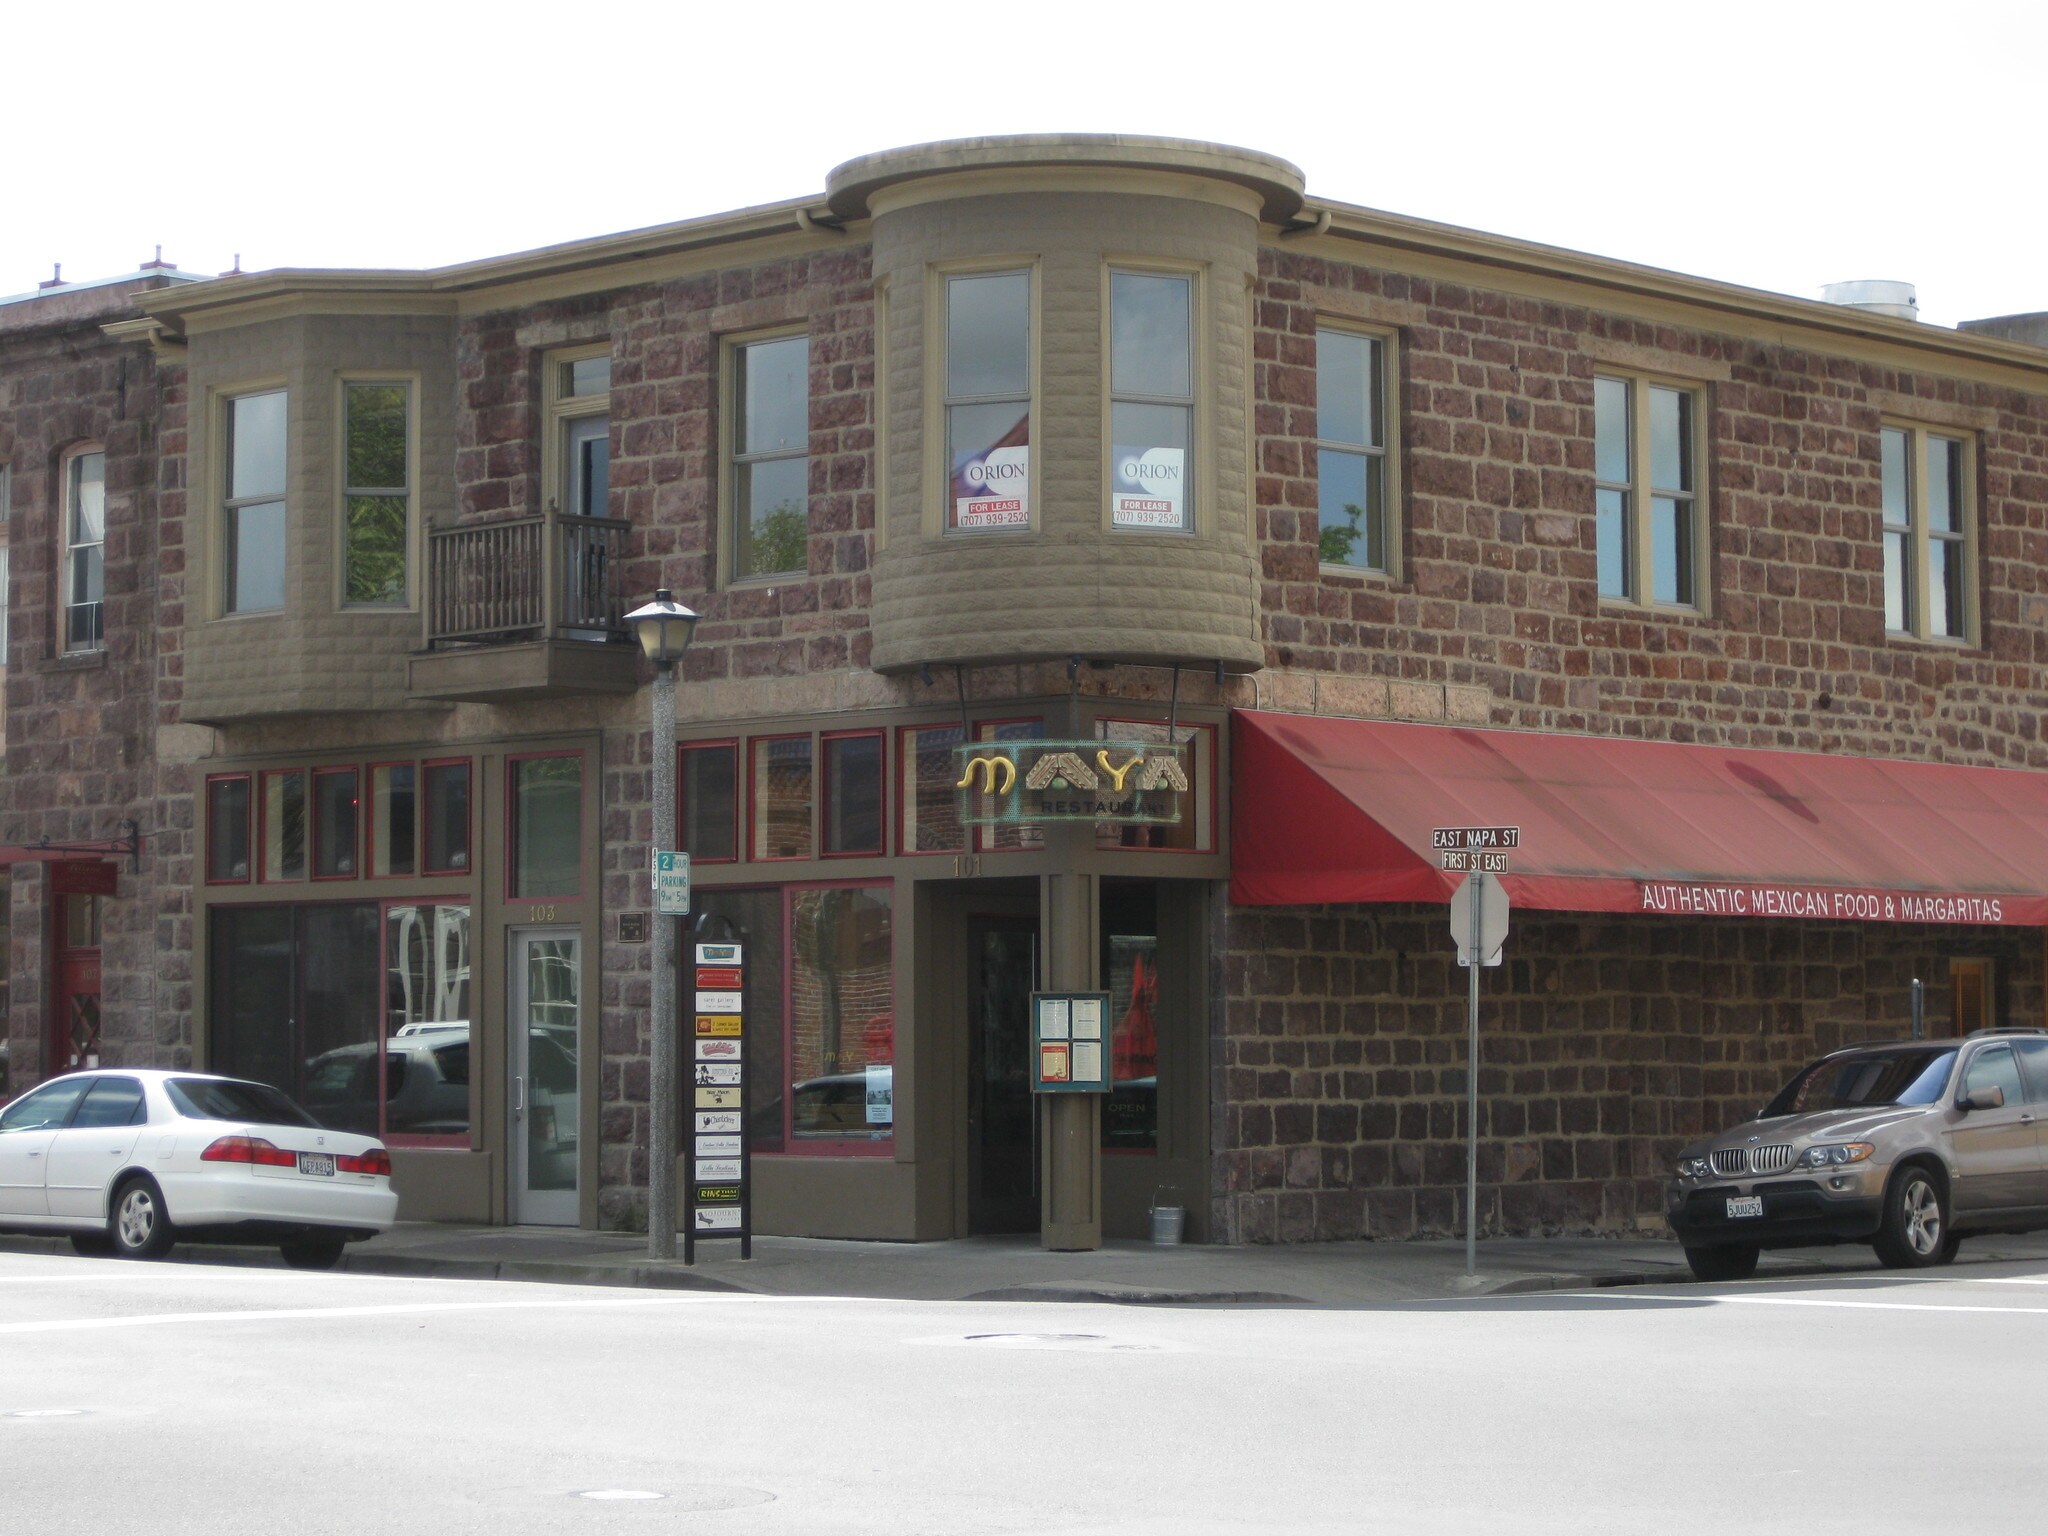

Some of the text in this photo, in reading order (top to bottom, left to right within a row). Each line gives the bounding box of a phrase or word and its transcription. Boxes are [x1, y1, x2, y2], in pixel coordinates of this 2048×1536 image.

[970, 463, 1025, 481] ORION
[1124, 462, 1179, 479] ORION
[970, 501, 1019, 512] FOR LEASE
[1124, 501, 1167, 510] FOR LEASE
[960, 512, 1029, 526] (707) 939-2520
[1113, 511, 1180, 524] (707) 939-2520
[956, 750, 1189, 796] MAYA
[1433, 830, 1517, 847] EAST NAPA ST
[662, 855, 687, 869] 2 HOUR
[952, 855, 982, 877] 101
[1444, 852, 1506, 871] FIRST ST EAST
[661, 876, 687, 888] PARKING
[1643, 885, 2002, 921] AUTHENTIC MEXICAN FOOD & MARGARITAS
[528, 904, 555, 922] 103
[82, 968, 97, 980] 107
[1108, 1103, 1145, 1113] OPEN
[1728, 1202, 1761, 1216] 5JUU252
